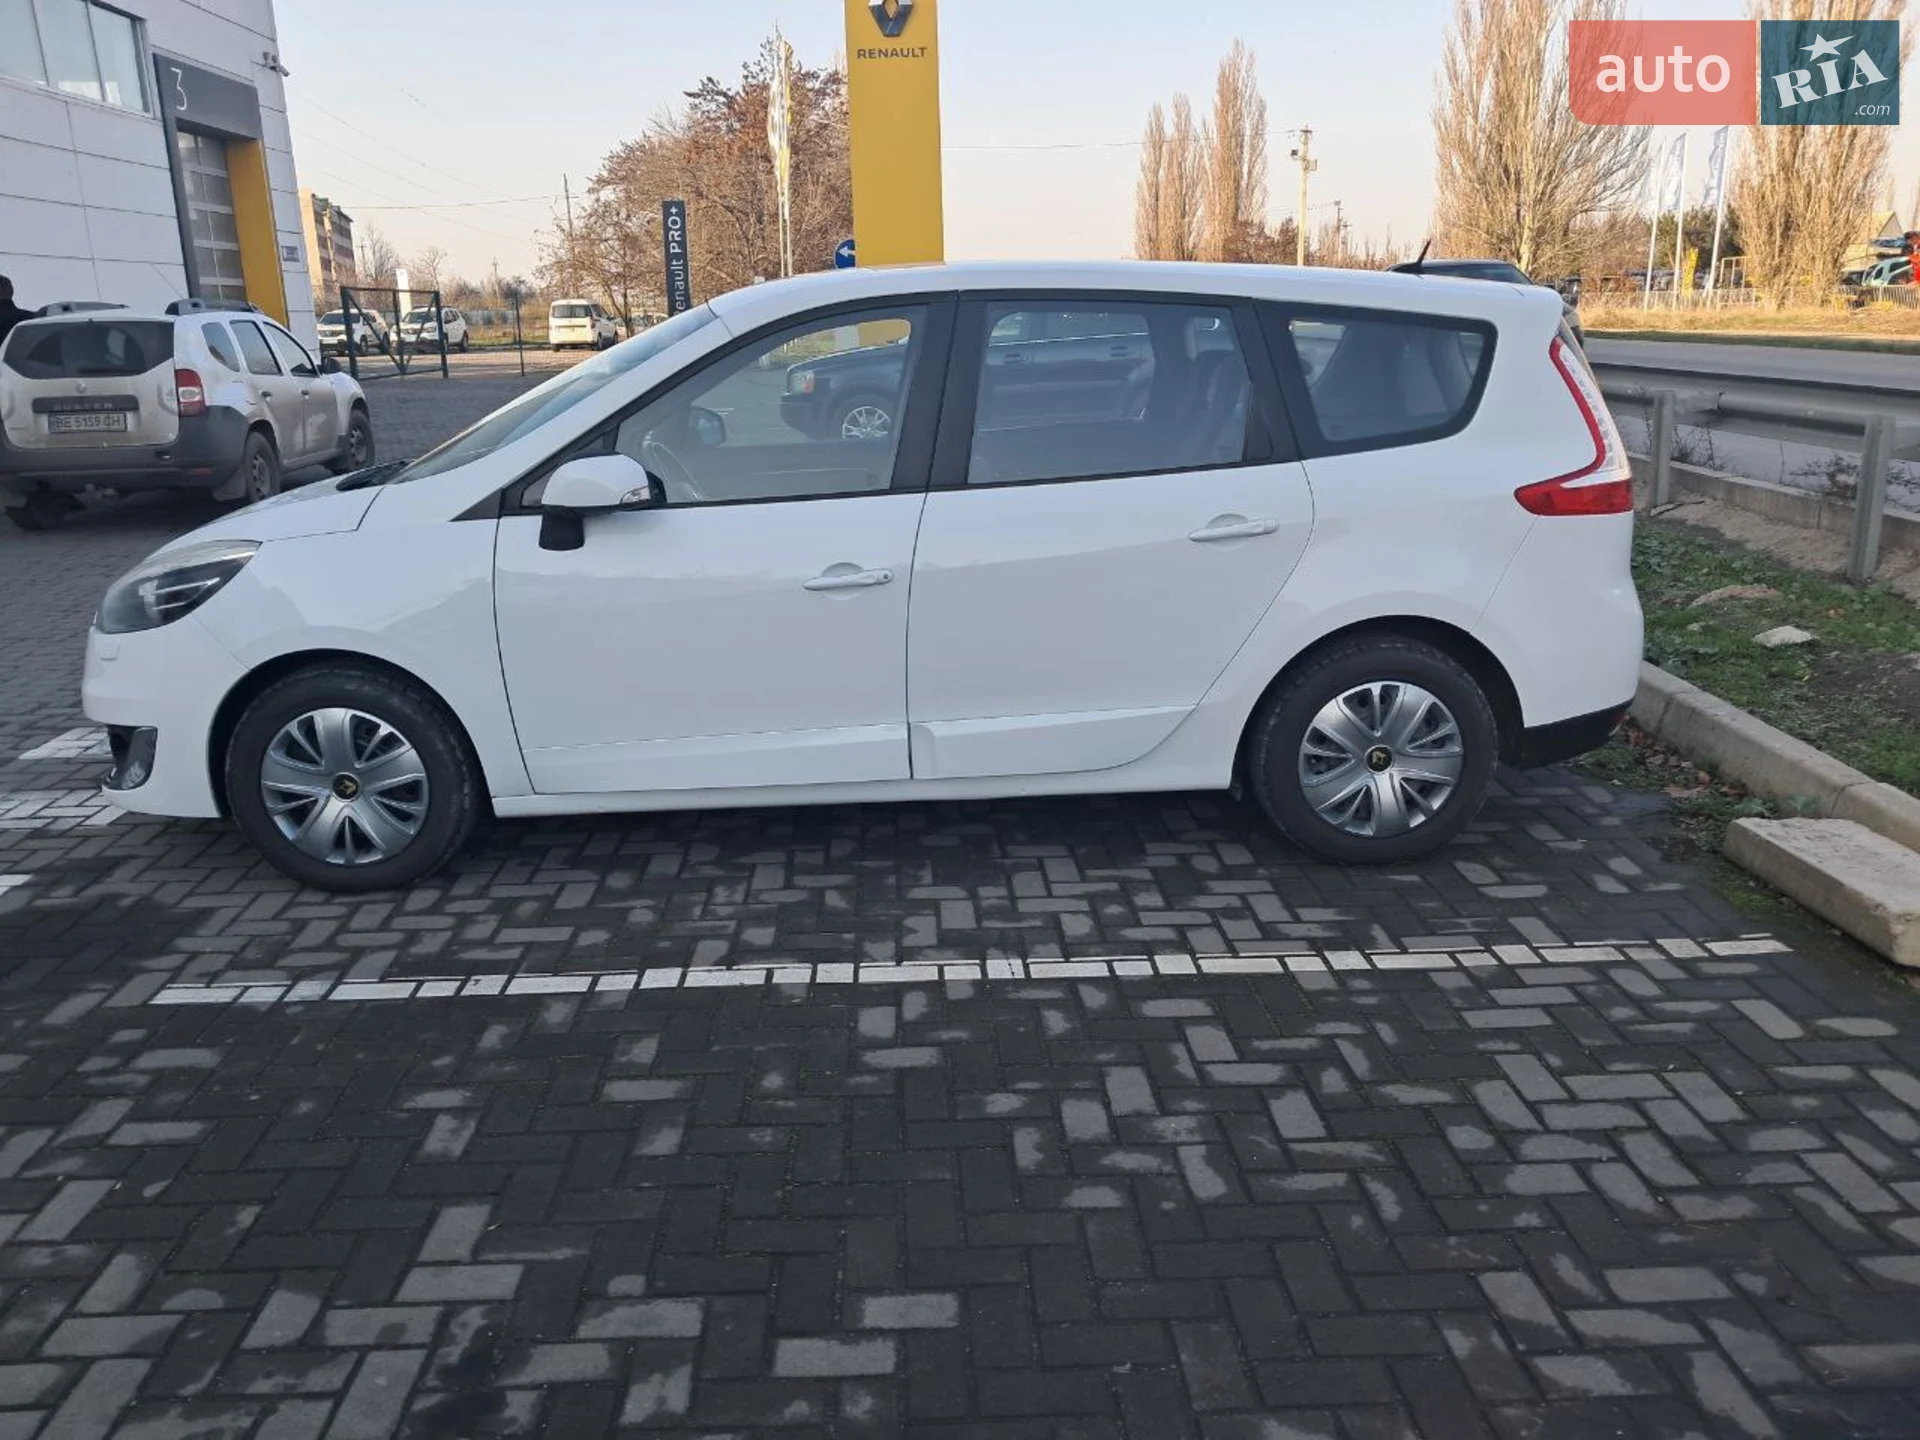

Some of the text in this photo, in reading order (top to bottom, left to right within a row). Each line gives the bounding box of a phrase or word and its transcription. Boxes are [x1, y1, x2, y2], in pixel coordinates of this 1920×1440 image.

[857, 46, 928, 59] RENAULT
[170, 67, 187, 110] 3
[668, 206, 683, 254] PRO+
[56, 416, 72, 428] BE
[74, 415, 101, 428] 5159
